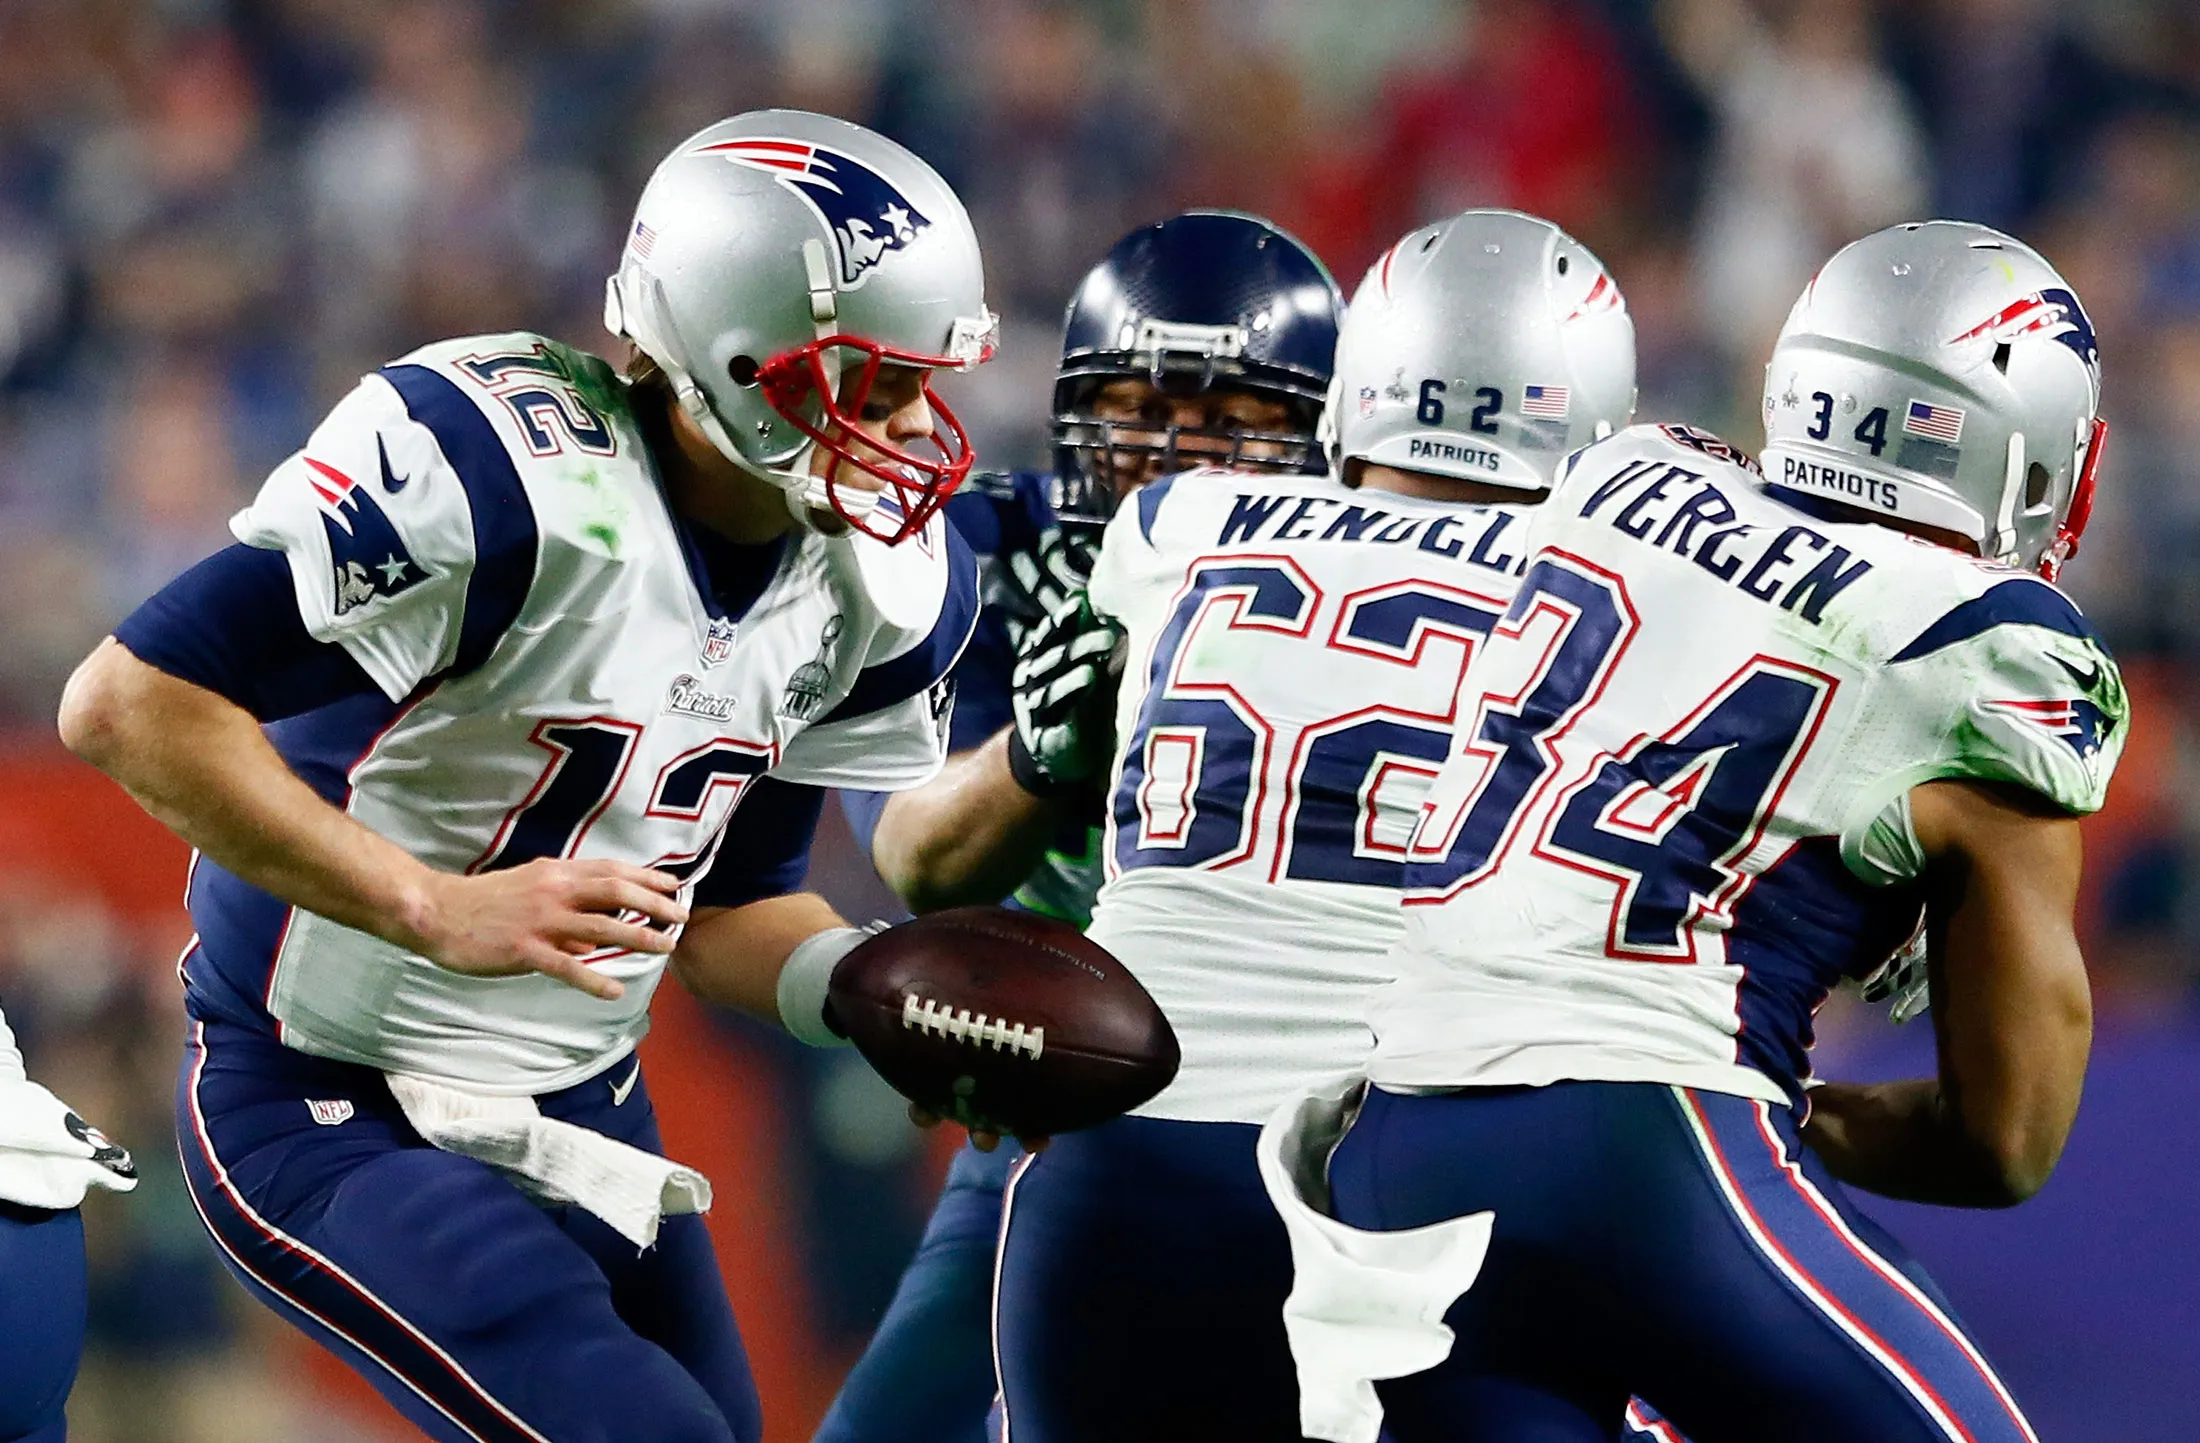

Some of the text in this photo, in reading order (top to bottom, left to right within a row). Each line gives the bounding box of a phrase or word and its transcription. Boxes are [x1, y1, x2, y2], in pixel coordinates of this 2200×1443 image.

[450, 343, 617, 458] 12
[1417, 379, 1503, 435] 62
[1807, 391, 1889, 457] 34
[1410, 438, 1501, 473] PATRIOTS
[1783, 456, 1899, 512] PATRIOTS
[1216, 494, 1527, 577] WENDEL
[706, 639, 729, 661] NFL
[666, 685, 735, 721] Patriots
[1103, 554, 1509, 887] 62
[1402, 545, 1840, 963] 34
[318, 1100, 348, 1119] NFL
